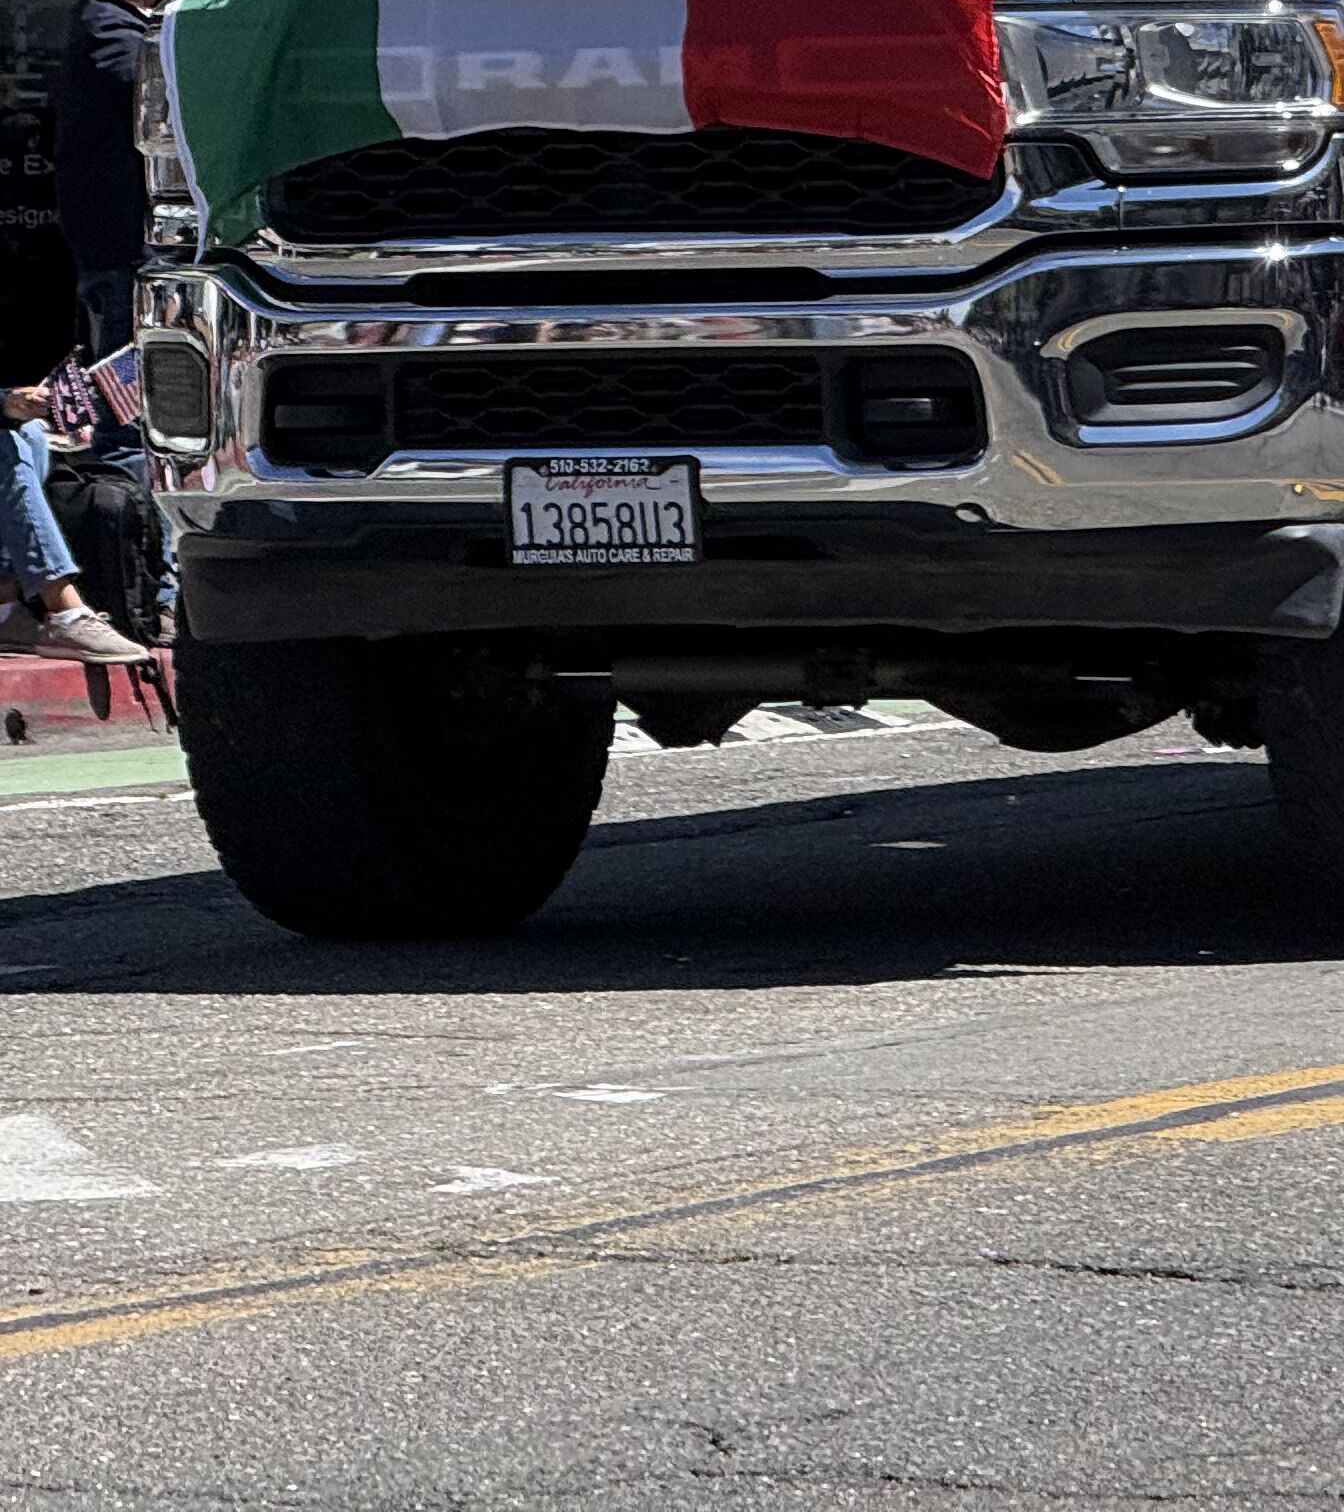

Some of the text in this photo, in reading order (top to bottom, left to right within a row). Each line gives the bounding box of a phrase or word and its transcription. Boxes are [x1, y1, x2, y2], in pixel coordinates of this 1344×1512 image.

[576, 548, 607, 563] AUTO
[609, 548, 640, 563] CARE
[641, 548, 651, 563] &
[653, 547, 694, 562] REPAIR
